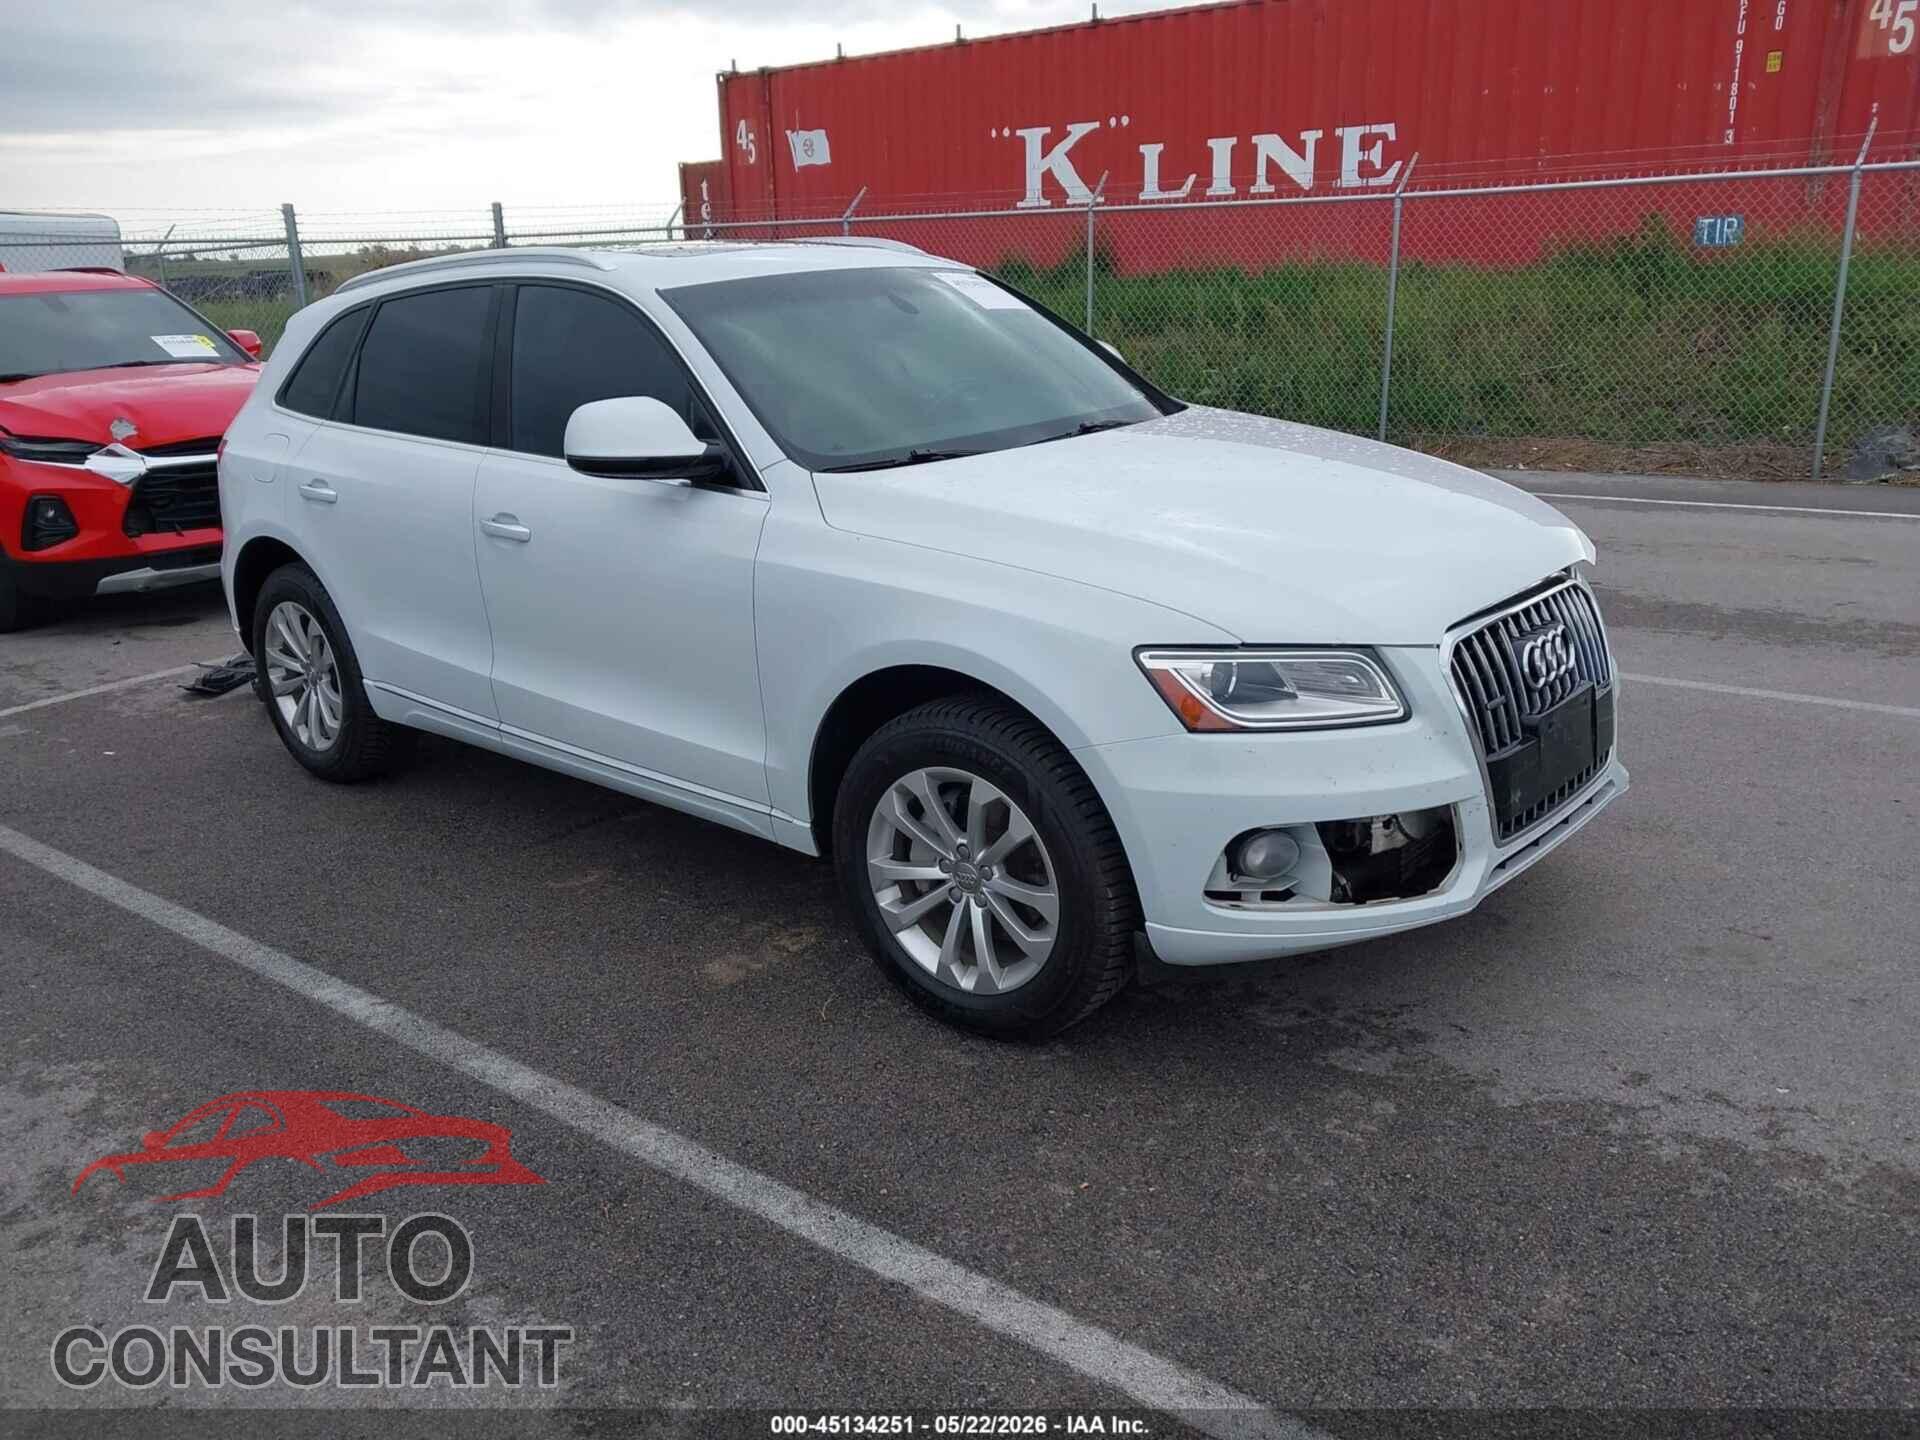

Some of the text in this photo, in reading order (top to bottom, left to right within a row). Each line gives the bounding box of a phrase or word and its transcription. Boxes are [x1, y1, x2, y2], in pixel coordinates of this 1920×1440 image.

[1869, 0, 1918, 54] 45
[1729, 39, 1743, 124] 911801
[736, 119, 756, 164] 45
[1139, 122, 1402, 200] LINE
